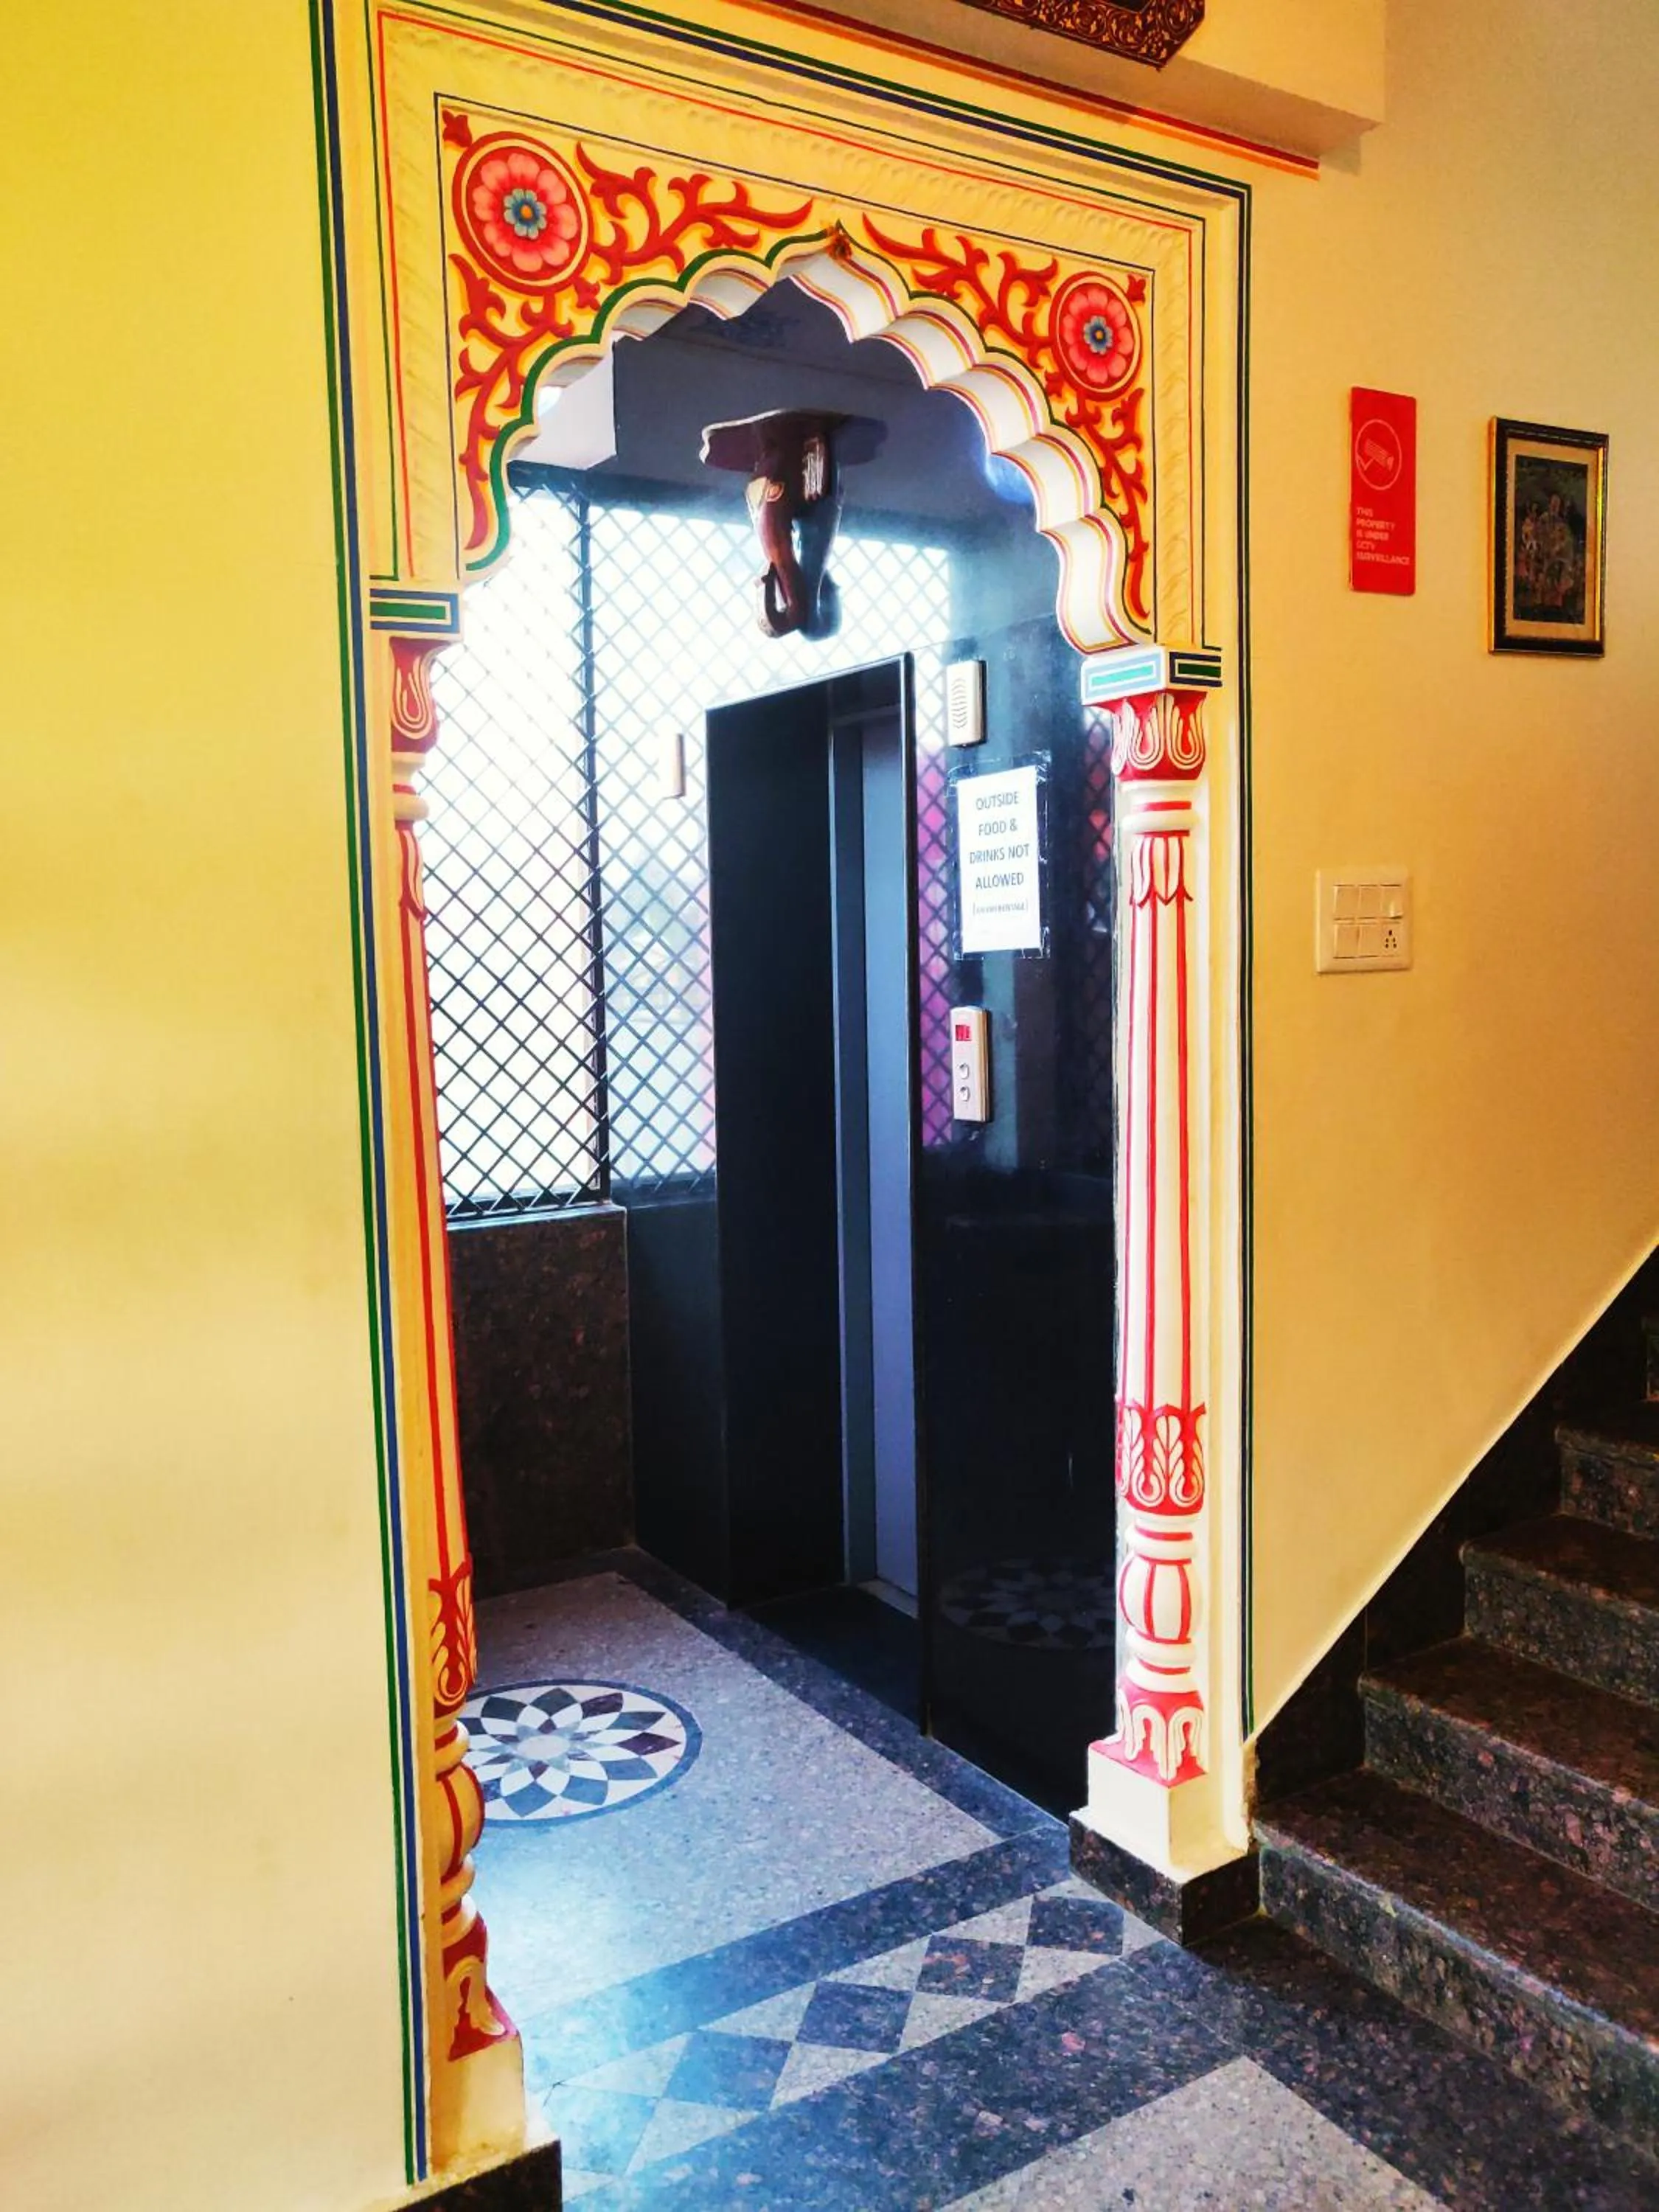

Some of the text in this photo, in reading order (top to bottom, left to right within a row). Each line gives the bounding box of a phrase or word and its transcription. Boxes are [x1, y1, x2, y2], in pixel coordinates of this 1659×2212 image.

[1356, 518, 1396, 531] PROPERTY
[1356, 540, 1376, 552] CCTV
[1356, 552, 1410, 566] SURVEILLANCE
[975, 791, 1020, 810] OUTSIDE
[978, 818, 1018, 836] FOOD &
[970, 844, 1029, 864] DRINKS NOT
[975, 872, 1024, 890] ALLOWED
